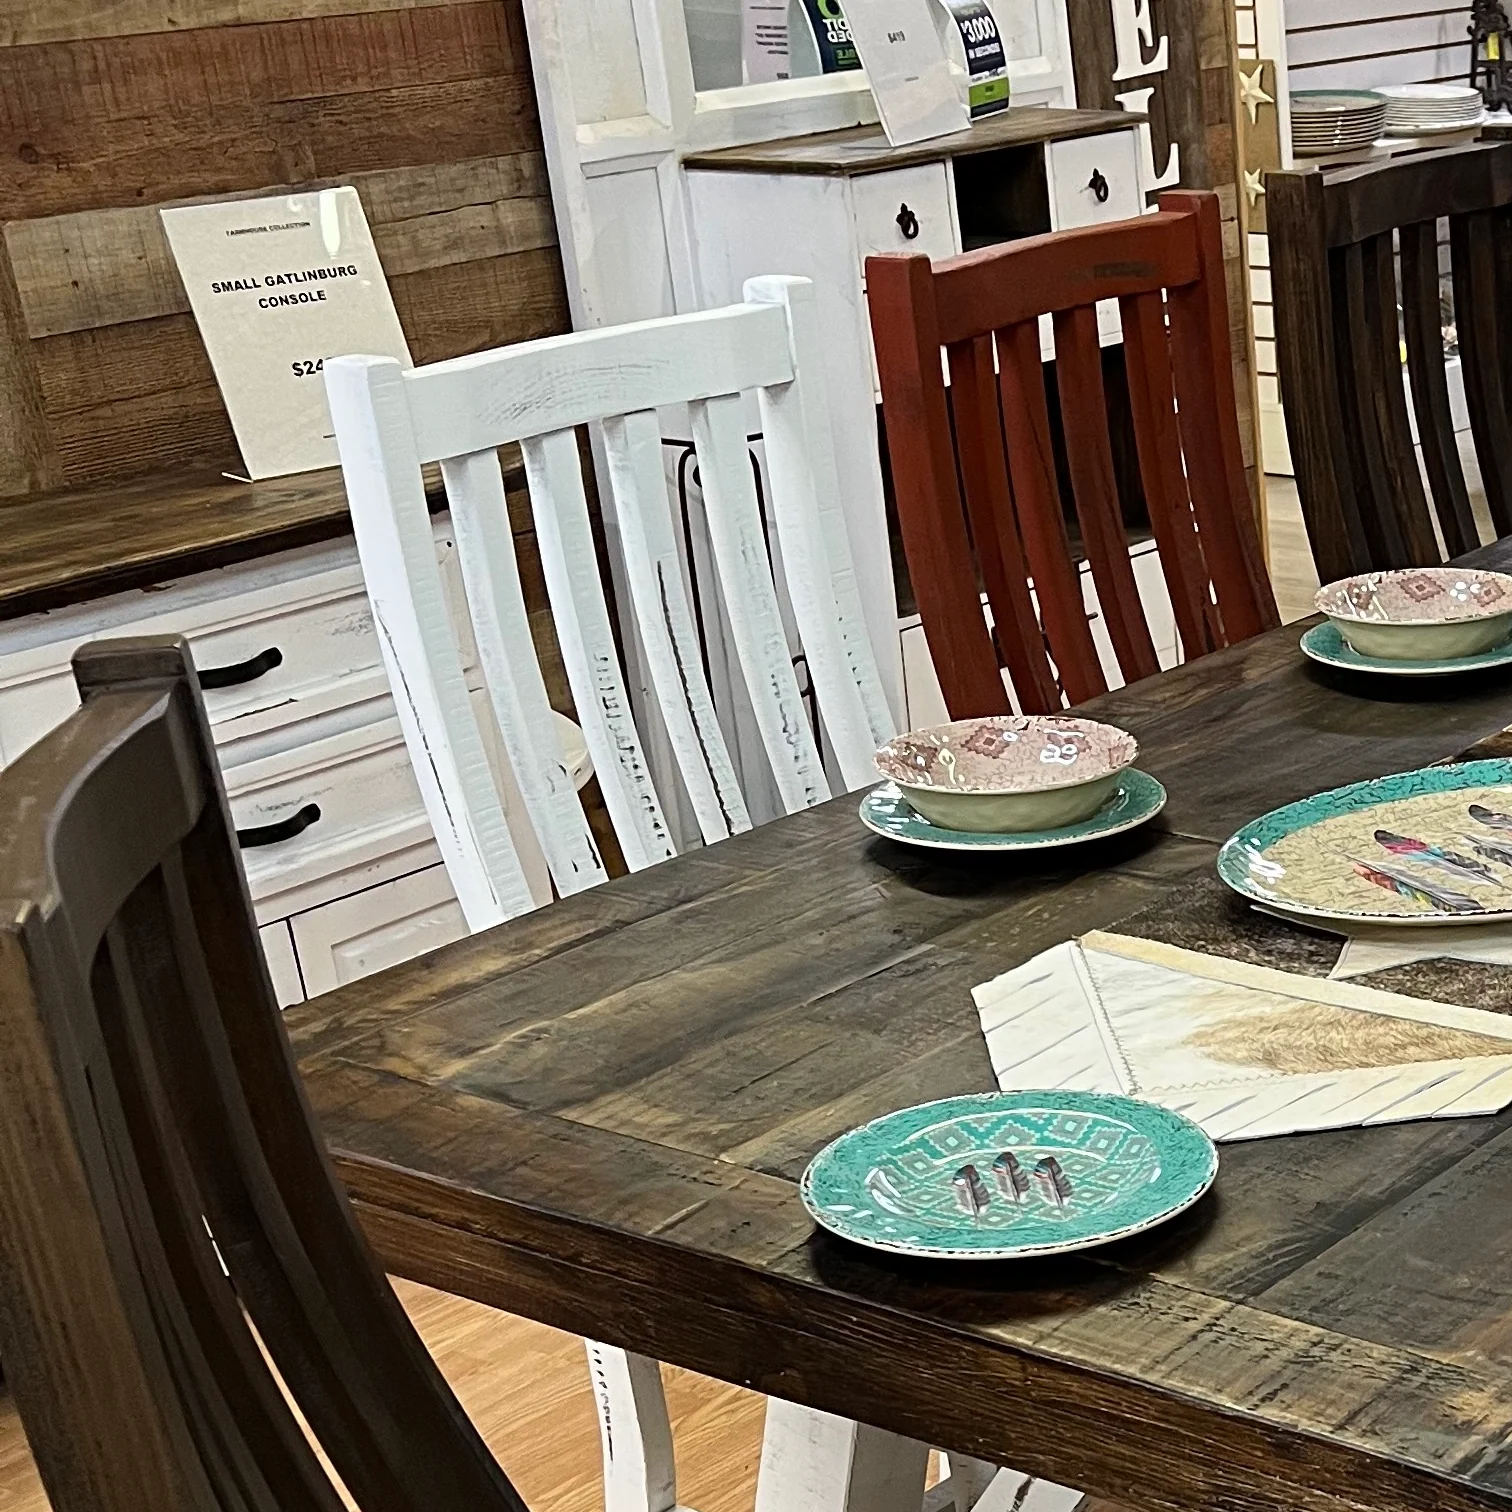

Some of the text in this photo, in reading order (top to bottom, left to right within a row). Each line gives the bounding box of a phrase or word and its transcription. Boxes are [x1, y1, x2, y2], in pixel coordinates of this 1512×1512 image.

[269, 221, 311, 233] COLLECTION
[211, 264, 359, 294] SMALL GATLINBURG
[258, 290, 327, 309] CONSOLE
[291, 357, 332, 378] $24
